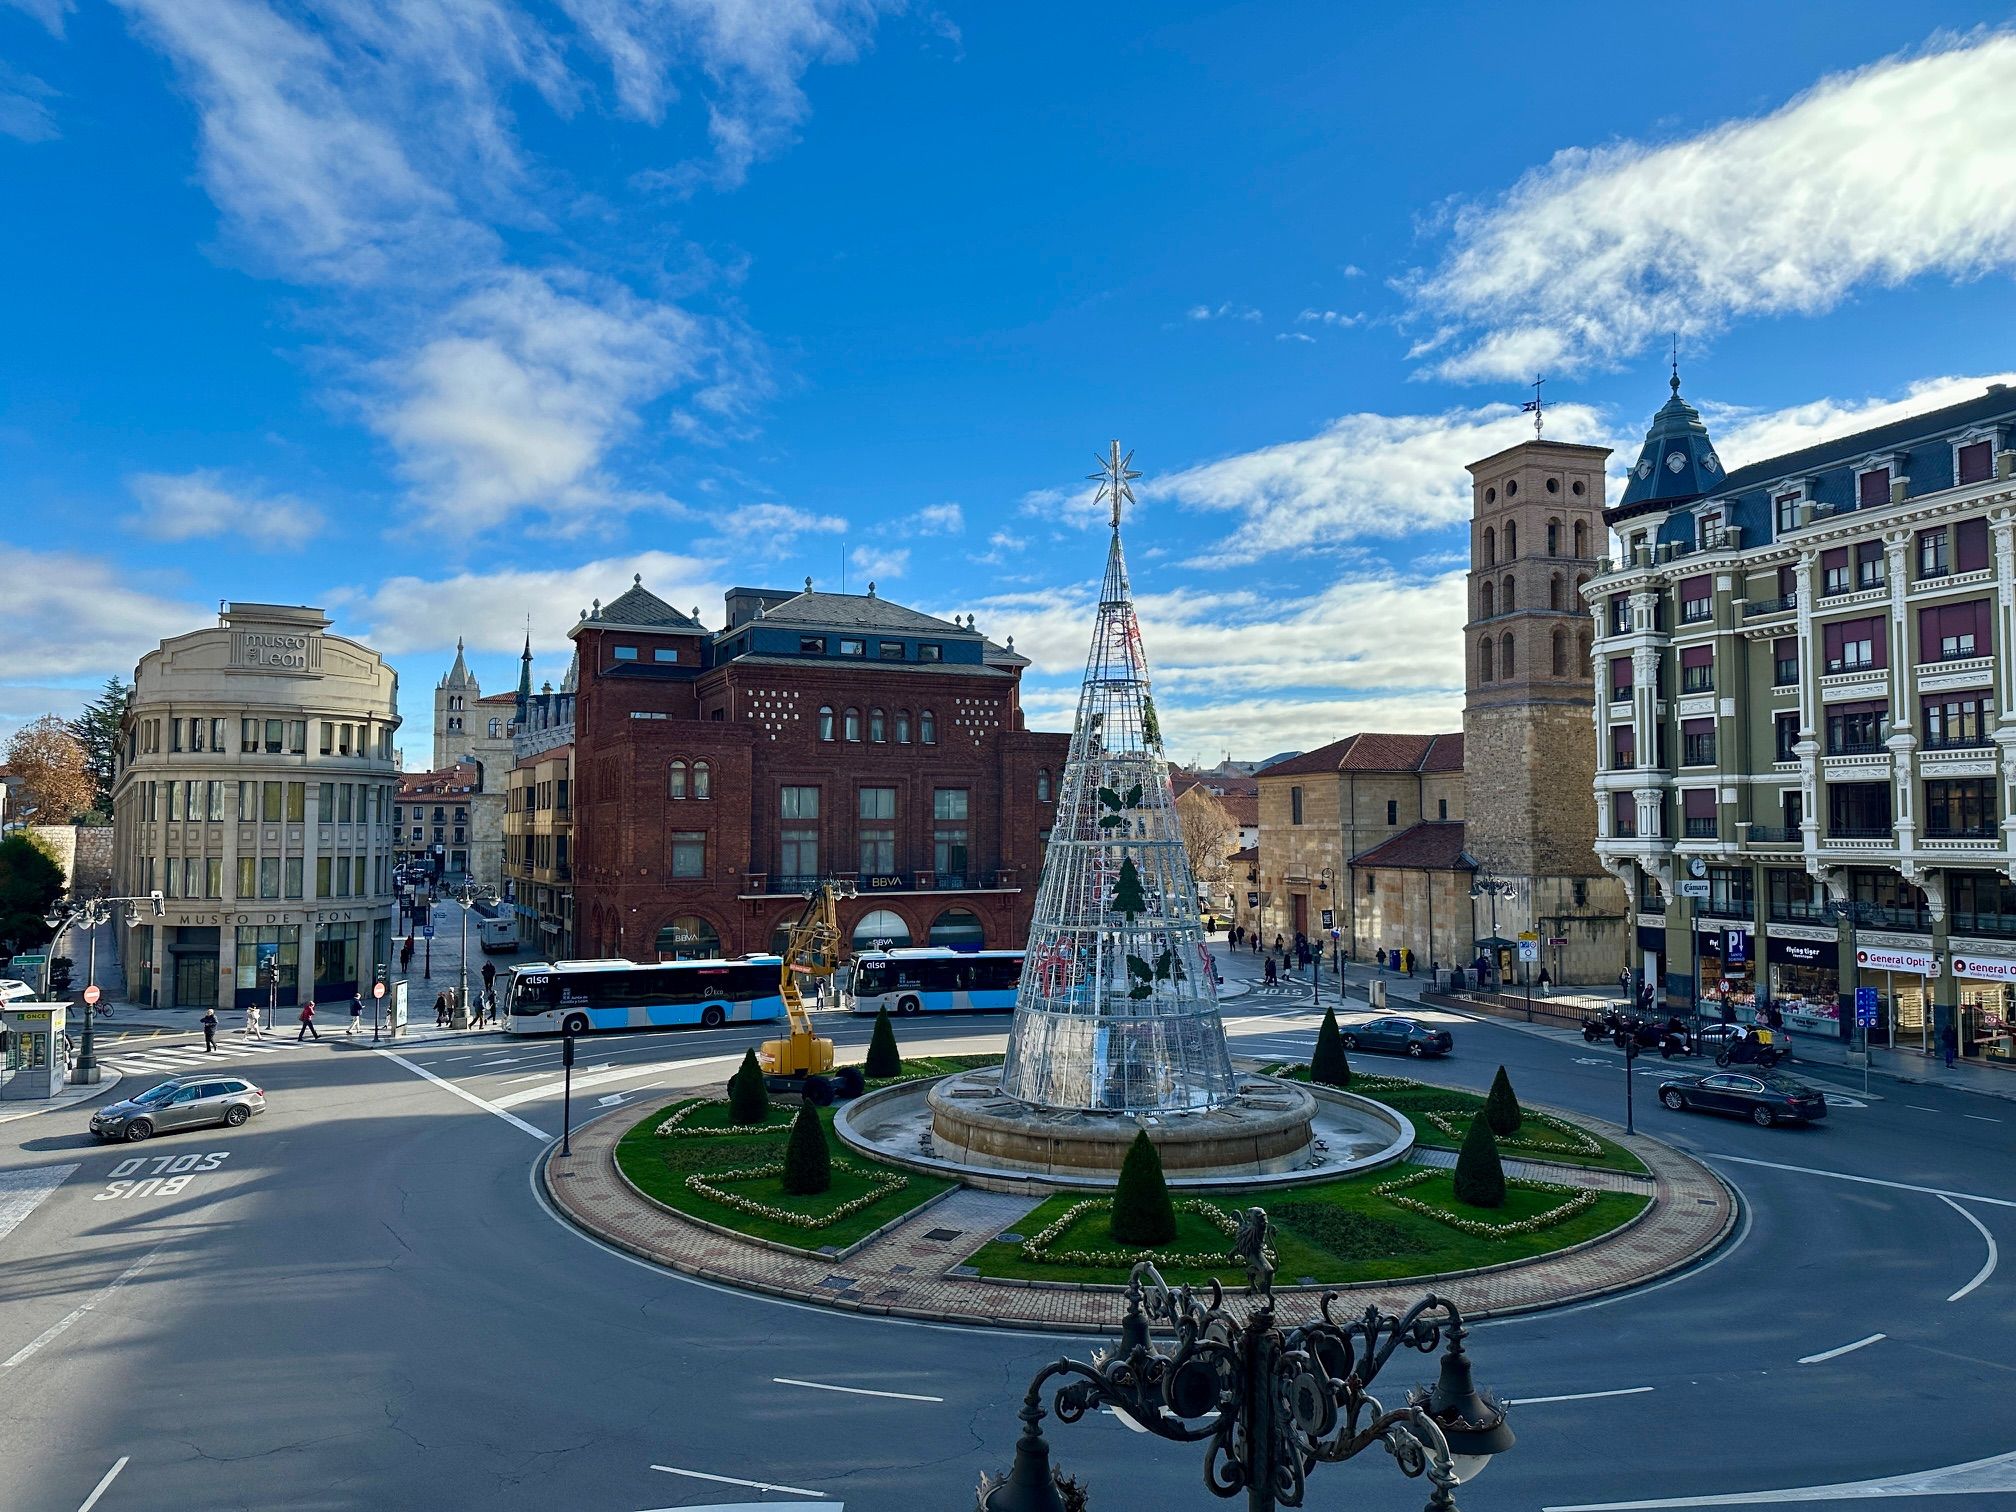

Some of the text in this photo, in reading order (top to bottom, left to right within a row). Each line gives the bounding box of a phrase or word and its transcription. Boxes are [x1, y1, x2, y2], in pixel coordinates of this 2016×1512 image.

[246, 634, 306, 649] museo
[259, 648, 305, 667] León
[872, 876, 902, 887] BBVA
[1684, 883, 1709, 892] Cámara
[179, 911, 352, 925] MUSEO DE LEON
[674, 933, 698, 942] BBVA
[872, 938, 894, 946] BBVA
[1709, 939, 1719, 947] flyi
[1728, 931, 1739, 953] P
[1786, 946, 1820, 956] flying tiger
[866, 961, 886, 969] alsa
[1870, 953, 1930, 968] General Opti
[1969, 962, 2007, 974] General
[525, 975, 549, 985] alsa
[1257, 988, 1303, 996] STOP
[106, 1151, 231, 1178] SOLO
[92, 1174, 196, 1201] BUS
